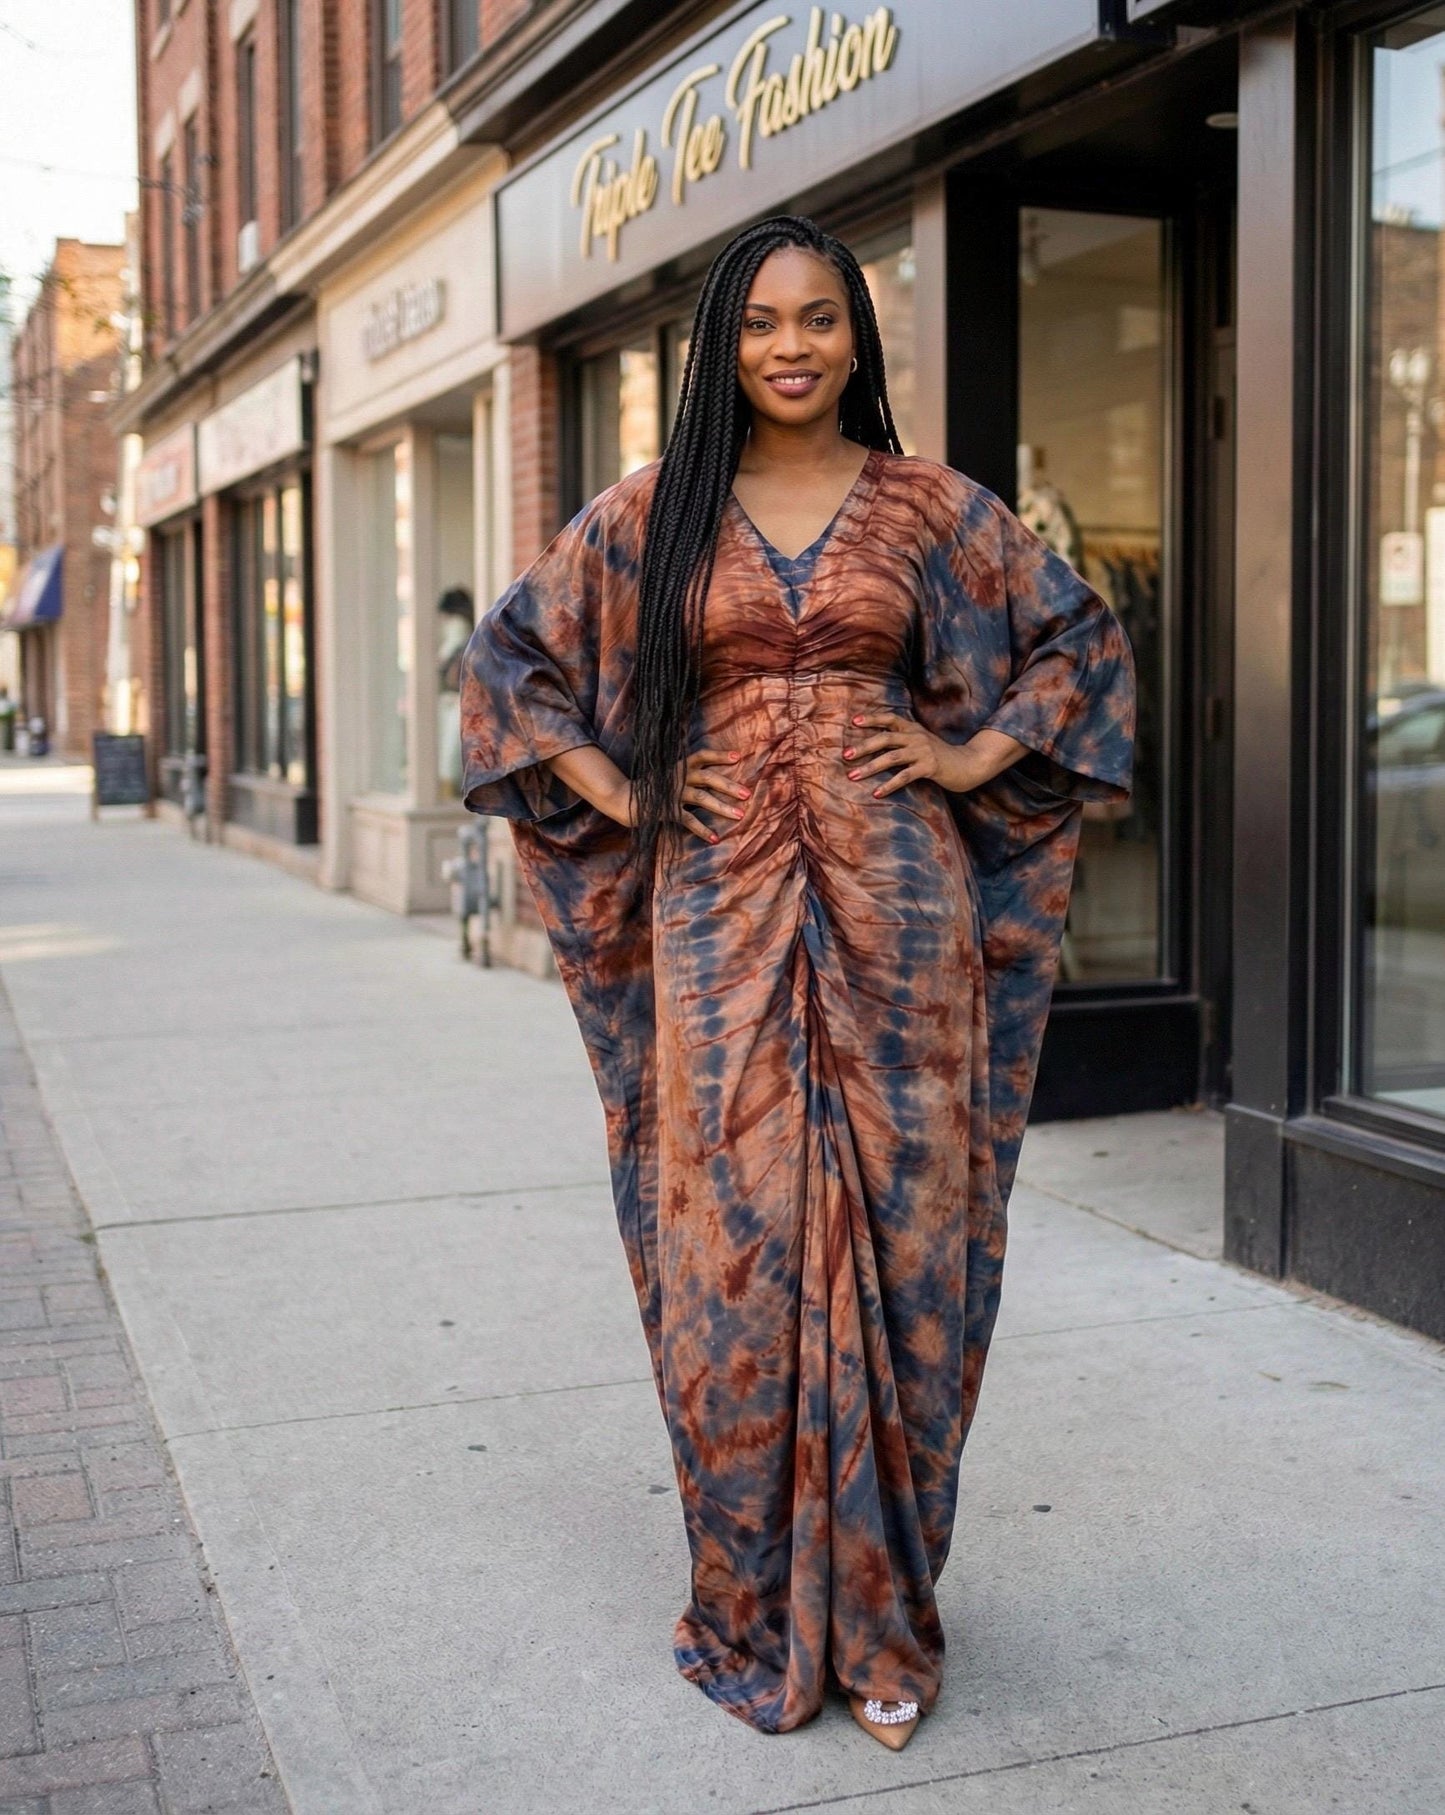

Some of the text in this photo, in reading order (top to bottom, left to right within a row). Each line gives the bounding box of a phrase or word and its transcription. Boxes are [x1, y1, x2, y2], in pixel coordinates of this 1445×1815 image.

[571, 6, 897, 261] Triple Tee Fashion
